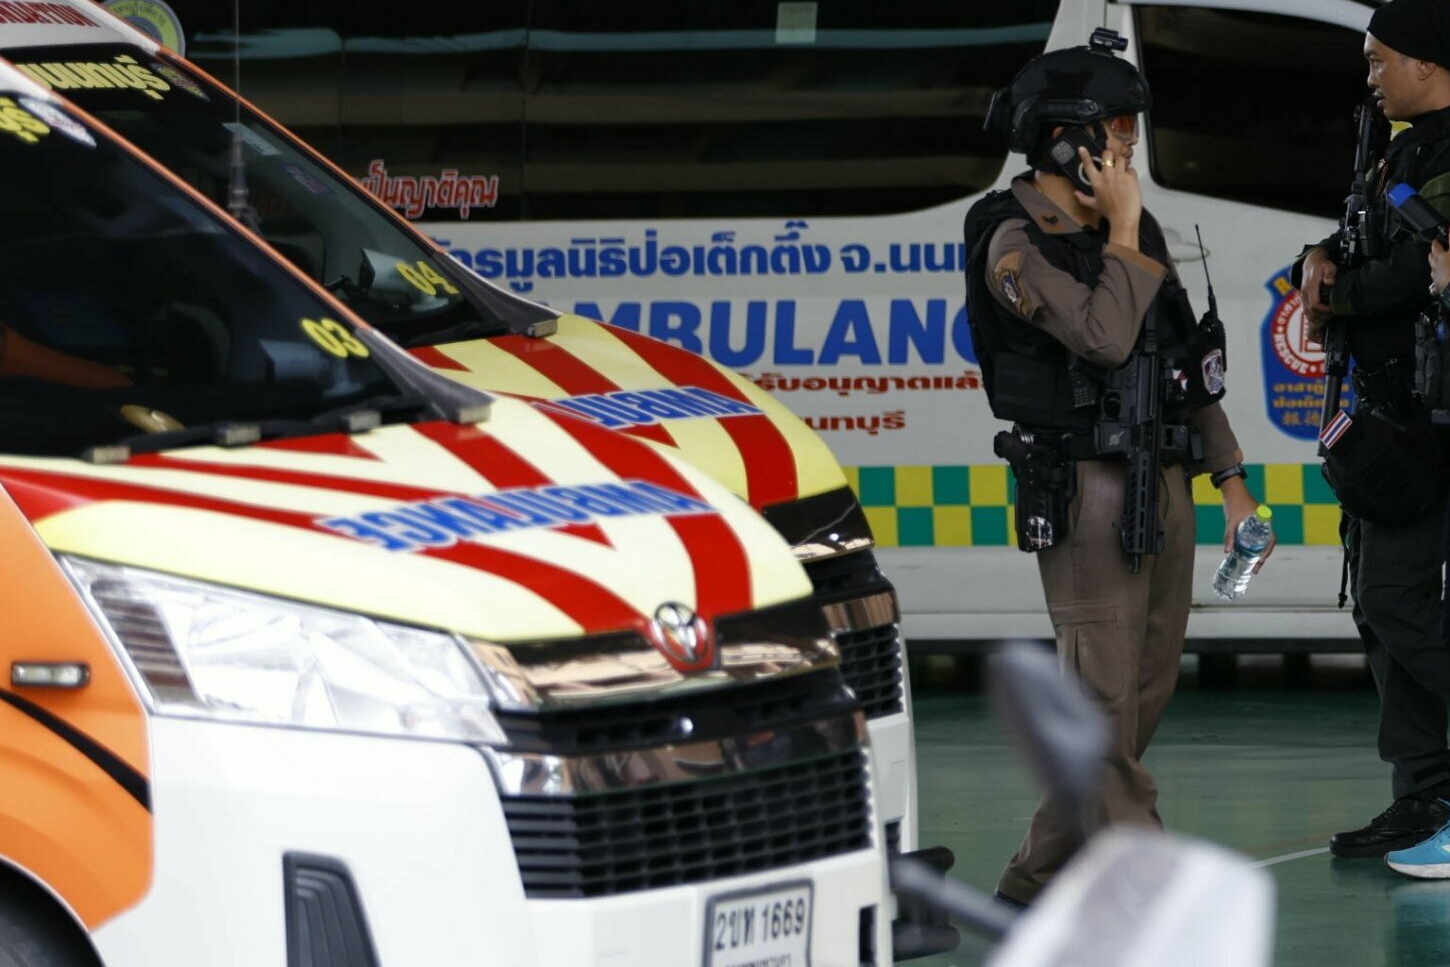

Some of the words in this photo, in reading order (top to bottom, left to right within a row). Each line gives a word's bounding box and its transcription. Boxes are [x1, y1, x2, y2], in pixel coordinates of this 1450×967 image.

[0, 0, 101, 28] NDATION
[395, 259, 460, 297] 04
[301, 317, 370, 359] 03
[761, 897, 806, 942] 1669
